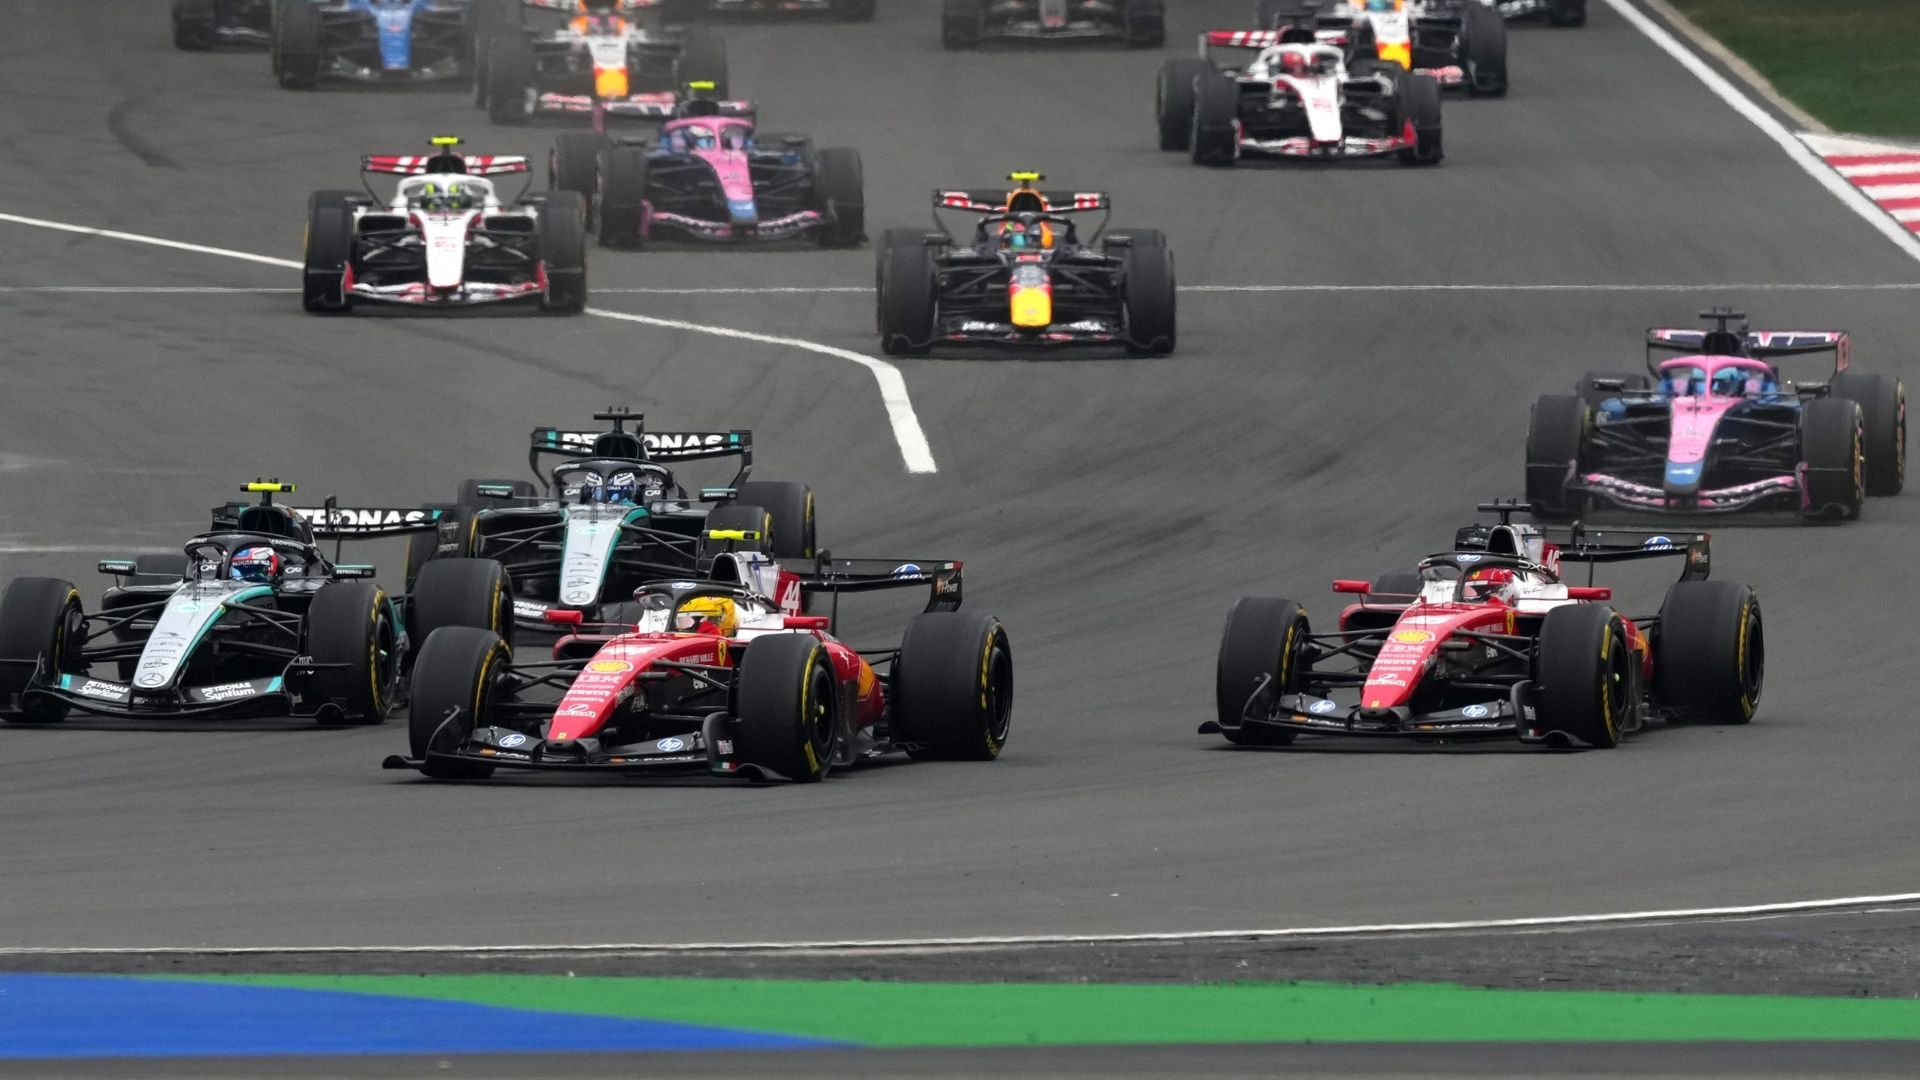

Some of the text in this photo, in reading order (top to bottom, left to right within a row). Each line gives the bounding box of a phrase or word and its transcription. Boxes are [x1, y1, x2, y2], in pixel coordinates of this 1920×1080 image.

[562, 433, 723, 456] PEONAS
[86, 680, 129, 692] PETRONAS
[201, 682, 251, 694] PETRONAS
[204, 688, 255, 700] Syntium
[658, 738, 683, 751] hp
